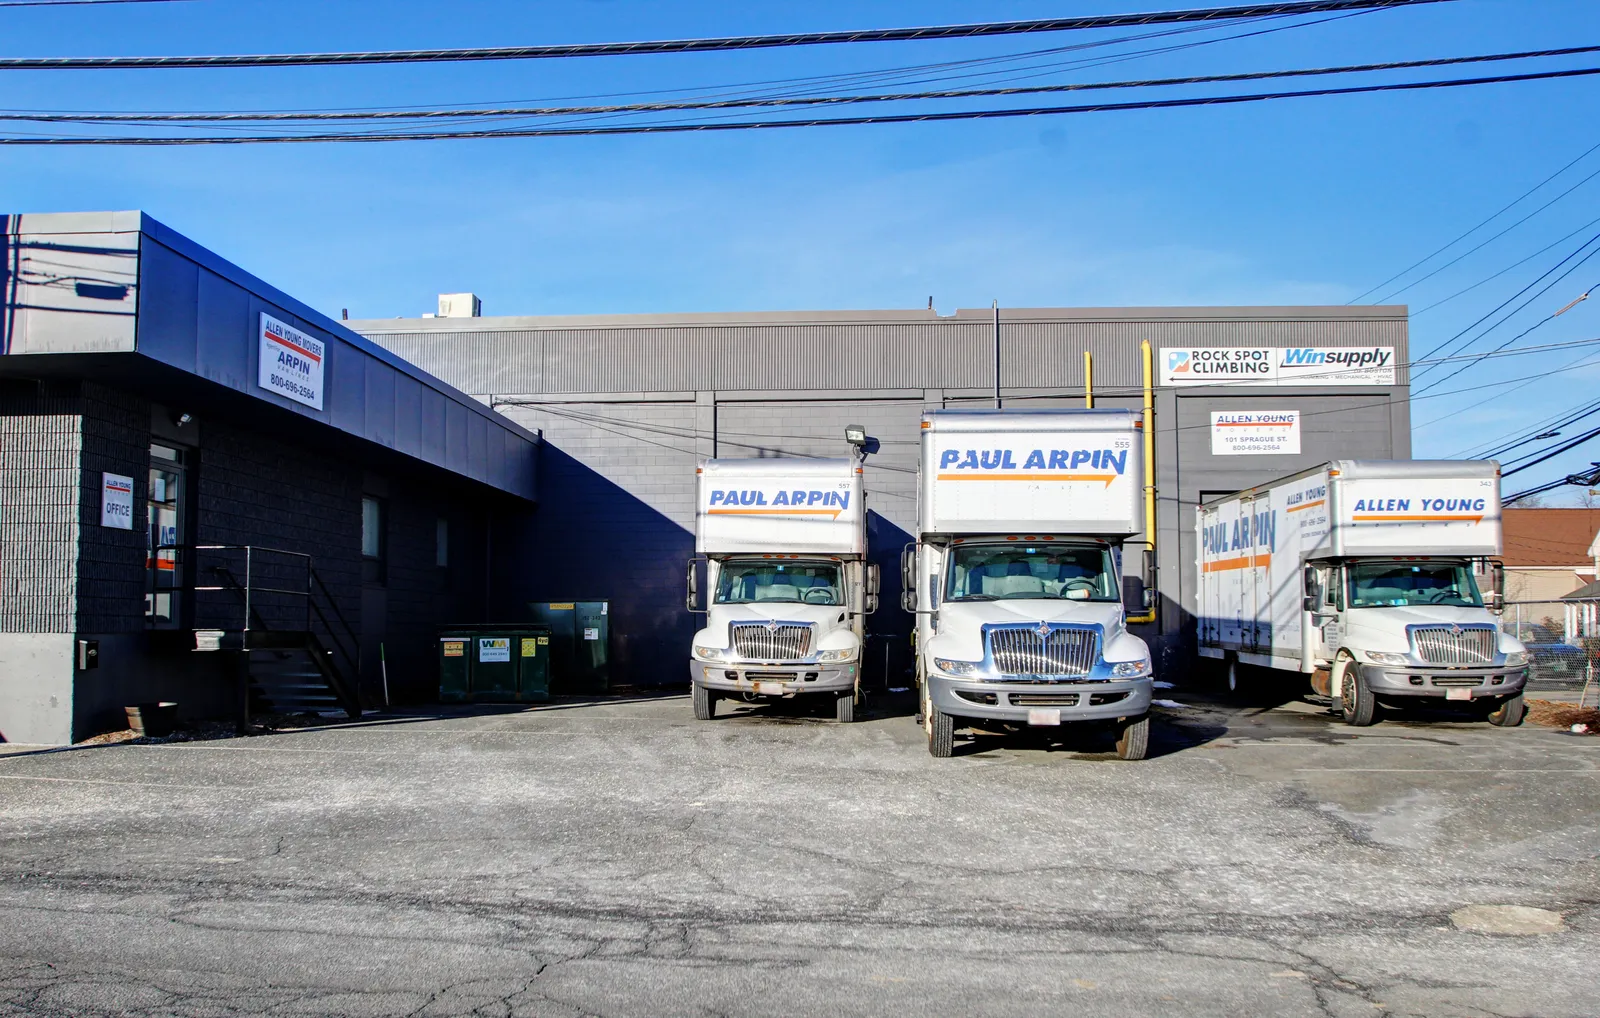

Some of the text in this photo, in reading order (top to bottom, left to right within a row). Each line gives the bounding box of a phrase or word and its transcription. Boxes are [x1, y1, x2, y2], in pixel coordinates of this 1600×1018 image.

[265, 320, 322, 356] ALLEN YOUNG MOVERS
[277, 351, 310, 375] ARPIN
[1192, 350, 1269, 361] ROCK SPOT
[1286, 348, 1391, 367] Winsupply
[1192, 362, 1270, 373] CLIMBING
[270, 373, 315, 400] 800-696-2564
[1217, 414, 1295, 423] ALLEN YOUNG
[939, 449, 1128, 475] PAUL ARPIN
[709, 490, 850, 510] PAUL ARPIN
[1287, 485, 1326, 506] ALLEN YOUNG
[1354, 499, 1485, 512] ALLEN YOUNG
[106, 502, 130, 517] OFFICE
[1203, 509, 1276, 555] PAUL ARPIN
